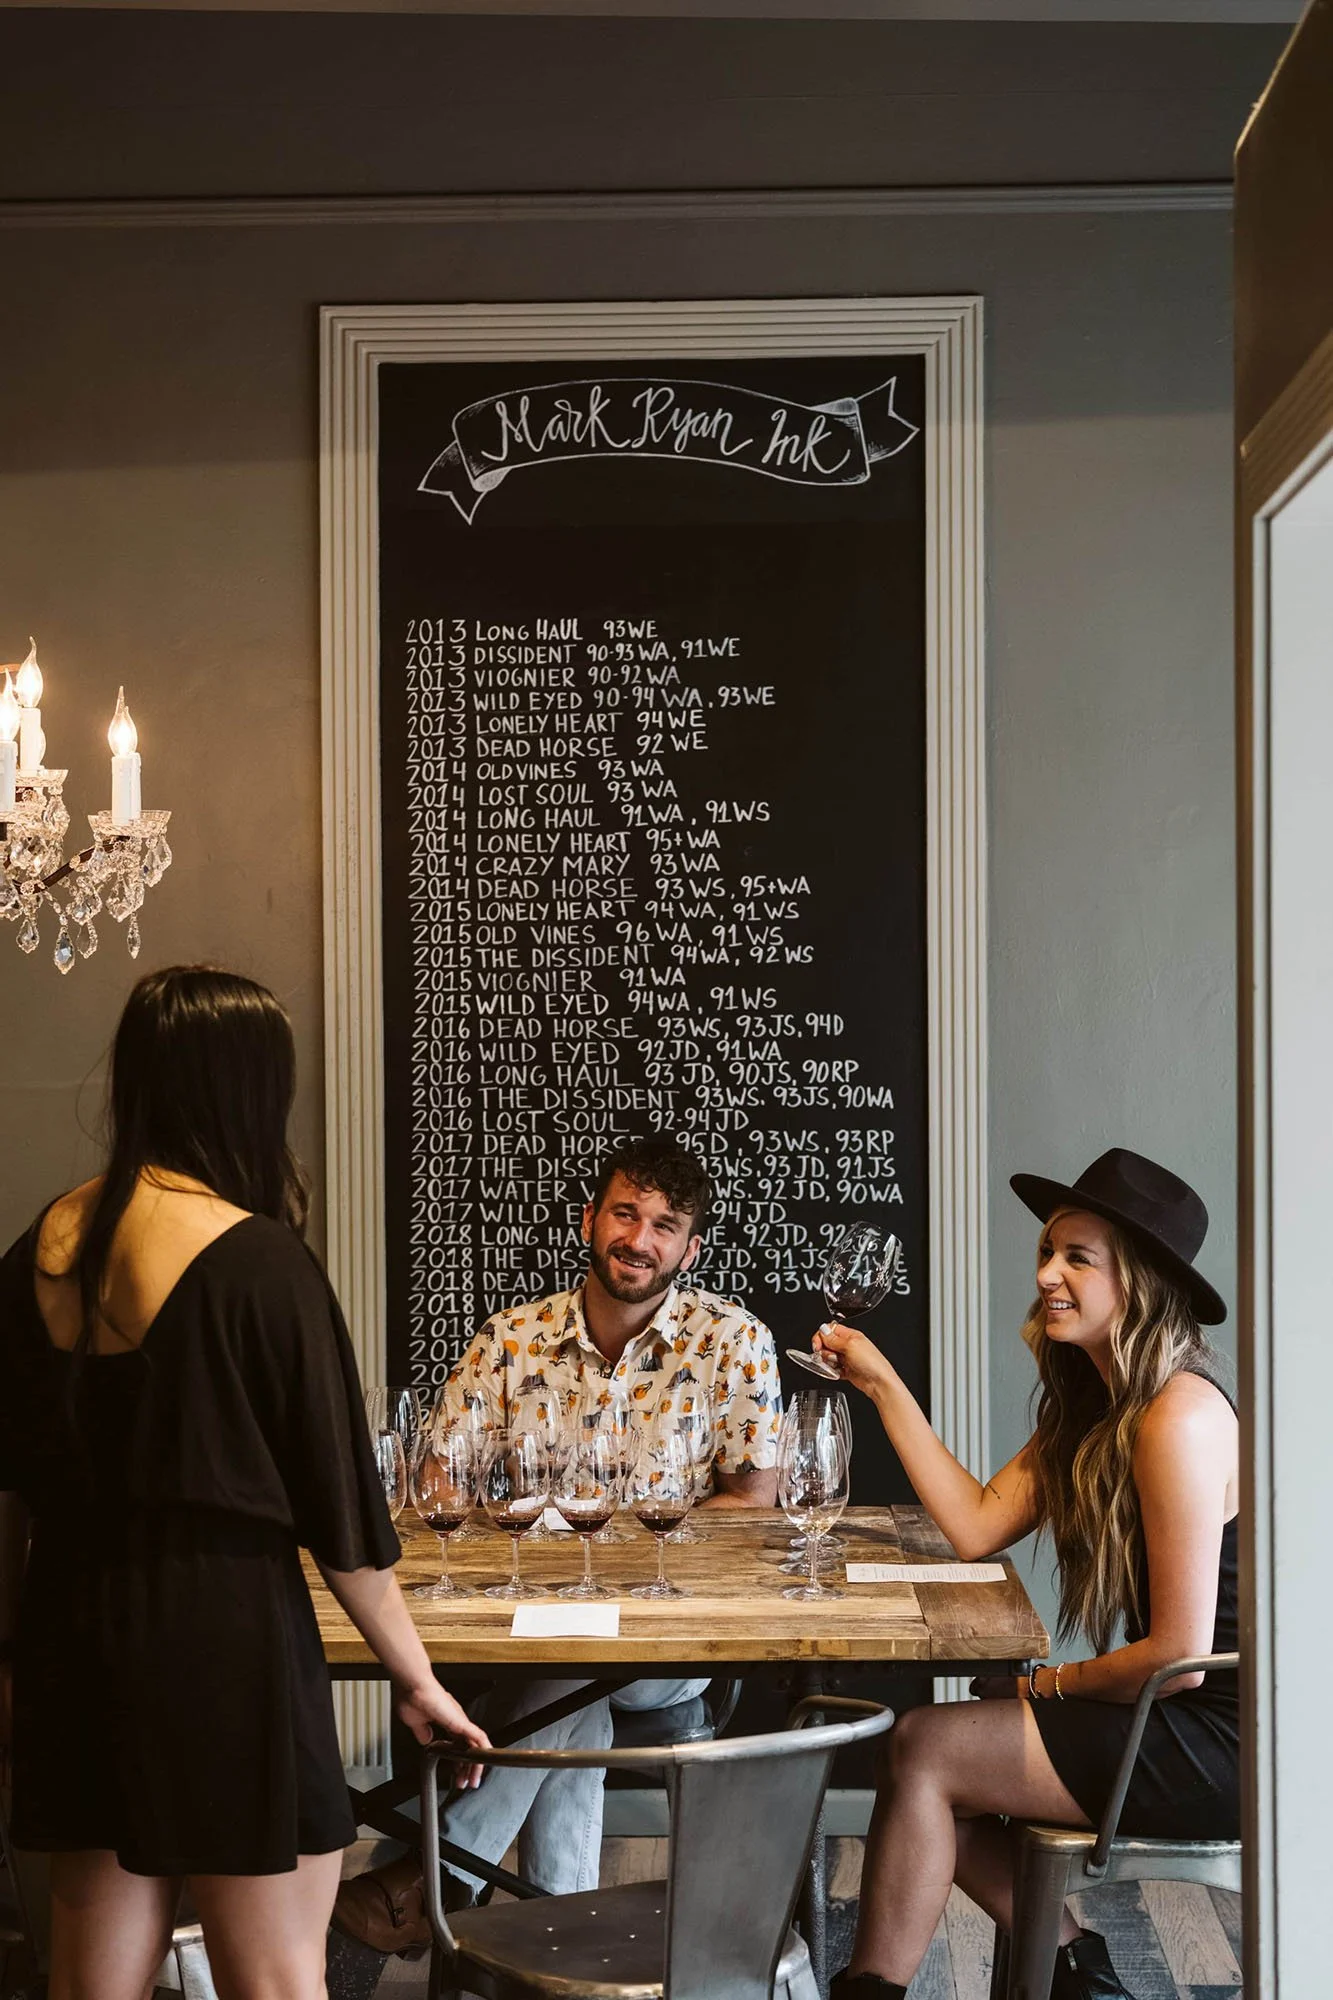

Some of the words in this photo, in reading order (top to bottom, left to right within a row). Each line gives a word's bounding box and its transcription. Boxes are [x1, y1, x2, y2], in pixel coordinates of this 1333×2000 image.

[482, 385, 628, 462] Mark
[632, 387, 752, 455] Ryan
[762, 409, 851, 473] Ink
[405, 618, 467, 645] 2013
[475, 620, 530, 642] LONG
[536, 617, 584, 641] HAUL
[405, 645, 466, 670] 2013
[474, 643, 577, 665] DISSIDENT
[405, 666, 466, 692] 2013
[473, 667, 576, 688] VIOGNIER
[407, 689, 466, 715] 2013
[472, 692, 520, 712] WILD
[528, 691, 583, 712] EYED
[406, 713, 467, 739] 2013
[476, 714, 549, 735] LONELY
[554, 712, 624, 734] HEART
[406, 736, 467, 763] 2013
[476, 736, 531, 758] DEAD
[539, 736, 618, 758] HORSE
[405, 760, 467, 787] 2014
[406, 782, 465, 810] 2014
[478, 784, 529, 807] LOST
[535, 782, 594, 806] SOUL
[407, 808, 467, 834] 2014
[477, 806, 536, 830] LONG
[544, 807, 601, 829] HAUL
[410, 832, 467, 857] 2014
[477, 832, 561, 854] LONELY
[570, 831, 631, 854] HEART
[408, 855, 467, 877] 2014
[475, 855, 555, 877] CRAZY
[562, 853, 631, 877] MARY
[407, 876, 470, 900] 2014
[477, 878, 540, 900] DEAD
[551, 878, 638, 900] HORSE
[410, 899, 472, 923] 2015
[477, 901, 550, 922] LONELY
[556, 899, 636, 921] HEART
[412, 923, 472, 945] 2015
[475, 925, 517, 946] OLD
[529, 924, 596, 945] VINES
[413, 946, 472, 969] 2015
[474, 947, 522, 969] THE
[531, 943, 655, 968] DISSIDENT
[413, 968, 473, 992] 2015
[477, 969, 597, 993] VIOGNIER
[414, 991, 472, 1017] 2015
[475, 993, 536, 1016] WILD
[544, 992, 610, 1016] EYED
[411, 1016, 471, 1040] 2016
[479, 1017, 543, 1040] DEAD
[553, 1016, 639, 1040] HORSE
[411, 1040, 472, 1063] 2016
[478, 1042, 537, 1063] WILD
[551, 1041, 620, 1065] EYED
[412, 1063, 472, 1086] 2016
[480, 1064, 547, 1087] LONG
[556, 1063, 635, 1088] HAUL
[412, 1086, 472, 1109] 2016
[478, 1086, 532, 1110] THE
[543, 1087, 680, 1110] DISSIDENT
[412, 1108, 473, 1133] 2016
[482, 1110, 545, 1133] LOST
[552, 1110, 630, 1134] SOUL
[411, 1131, 473, 1154] 2017
[483, 1134, 546, 1156] DEAD
[411, 1154, 473, 1178] 2017
[477, 1156, 524, 1179] THE
[411, 1177, 471, 1202] 2017
[479, 1179, 570, 1203] WATER
[410, 1200, 474, 1224] 2017
[478, 1202, 550, 1224] WILD
[409, 1223, 472, 1246] 2018
[481, 1225, 539, 1246] LONG
[410, 1246, 473, 1269] 2018
[480, 1246, 524, 1269] THE
[410, 1269, 475, 1293] 2018
[482, 1270, 545, 1293] DEAD
[407, 1293, 475, 1316] 2018
[409, 1316, 476, 1338] 2018
